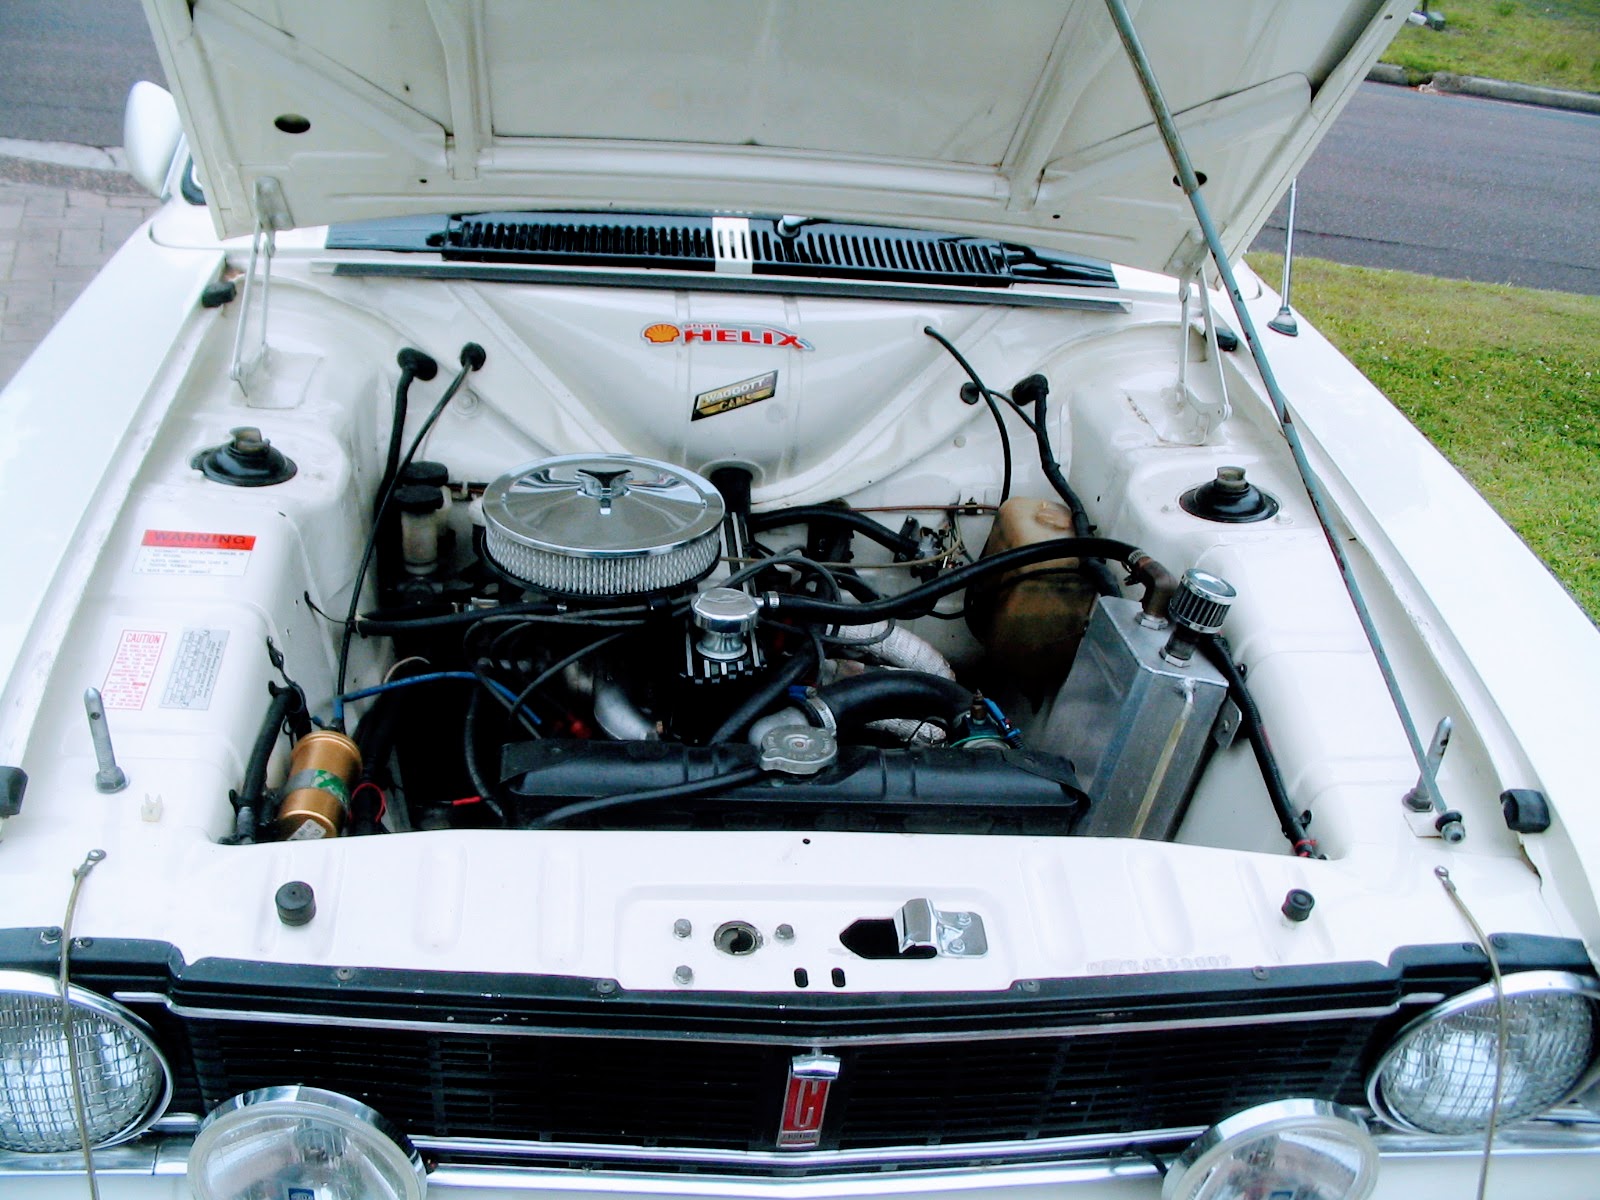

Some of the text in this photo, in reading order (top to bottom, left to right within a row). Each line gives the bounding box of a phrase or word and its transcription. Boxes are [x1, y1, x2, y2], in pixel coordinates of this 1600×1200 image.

[685, 328, 804, 349] HELIX
[703, 379, 765, 403] WAGGOTT
[719, 394, 754, 411] CAMS
[154, 531, 246, 544] WARNING
[125, 633, 161, 644] CAUTION
